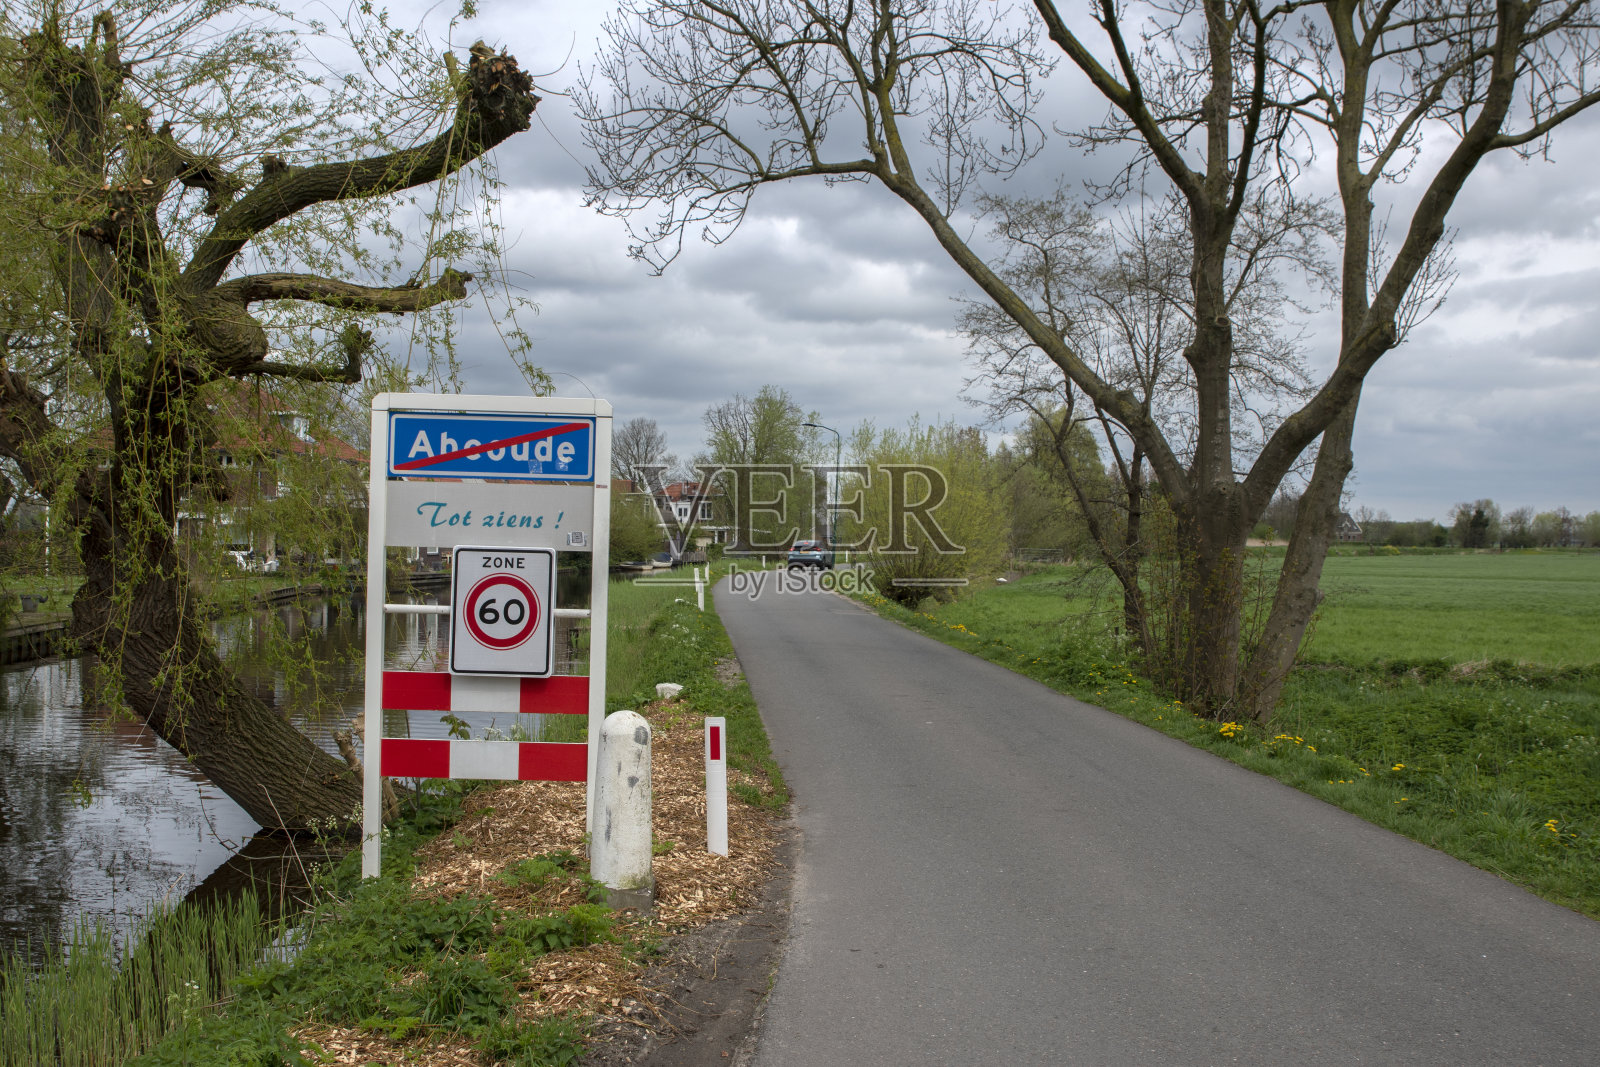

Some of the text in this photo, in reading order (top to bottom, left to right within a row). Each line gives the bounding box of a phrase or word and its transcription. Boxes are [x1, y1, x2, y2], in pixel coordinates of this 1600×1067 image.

[407, 430, 576, 462] Abcoude
[417, 501, 565, 529] Tot ziens !
[482, 556, 526, 569] ZONE
[478, 598, 525, 625] 60
